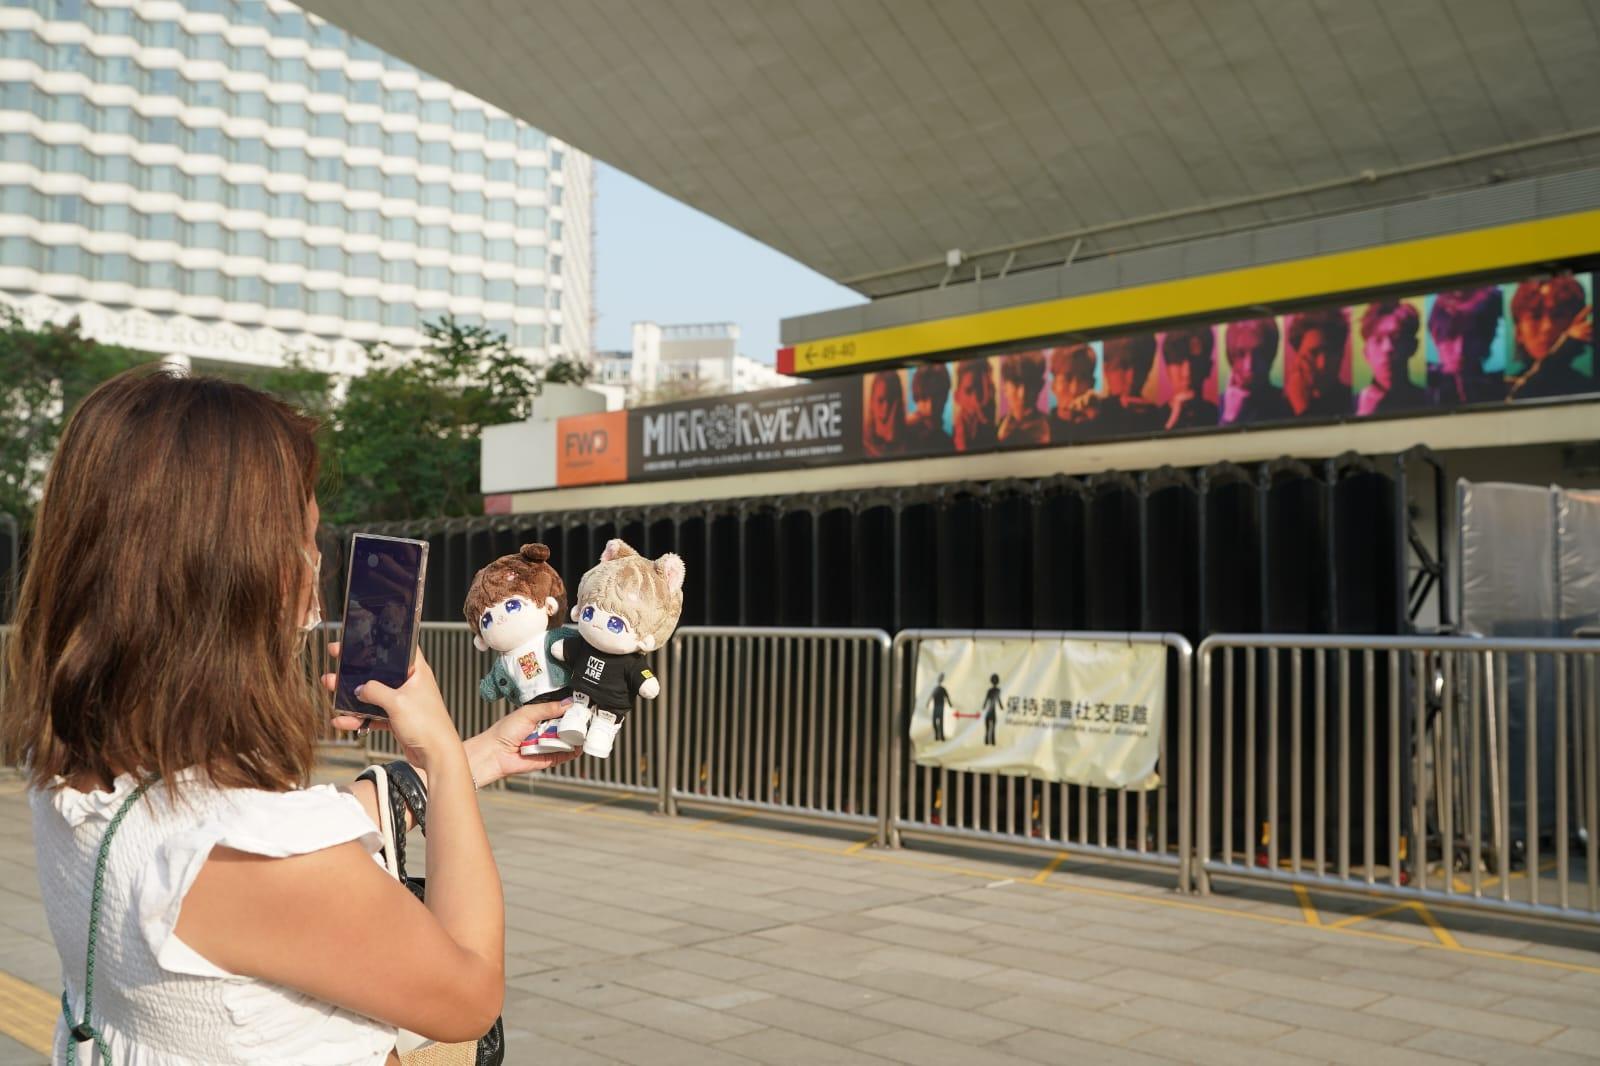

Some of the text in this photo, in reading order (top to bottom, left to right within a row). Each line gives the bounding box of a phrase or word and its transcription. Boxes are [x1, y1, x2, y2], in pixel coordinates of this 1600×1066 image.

[565, 428, 608, 456] FWD
[584, 667, 602, 681] ARE
[588, 656, 605, 672] WE
[1007, 696, 1148, 724] 保持適當社交距離
